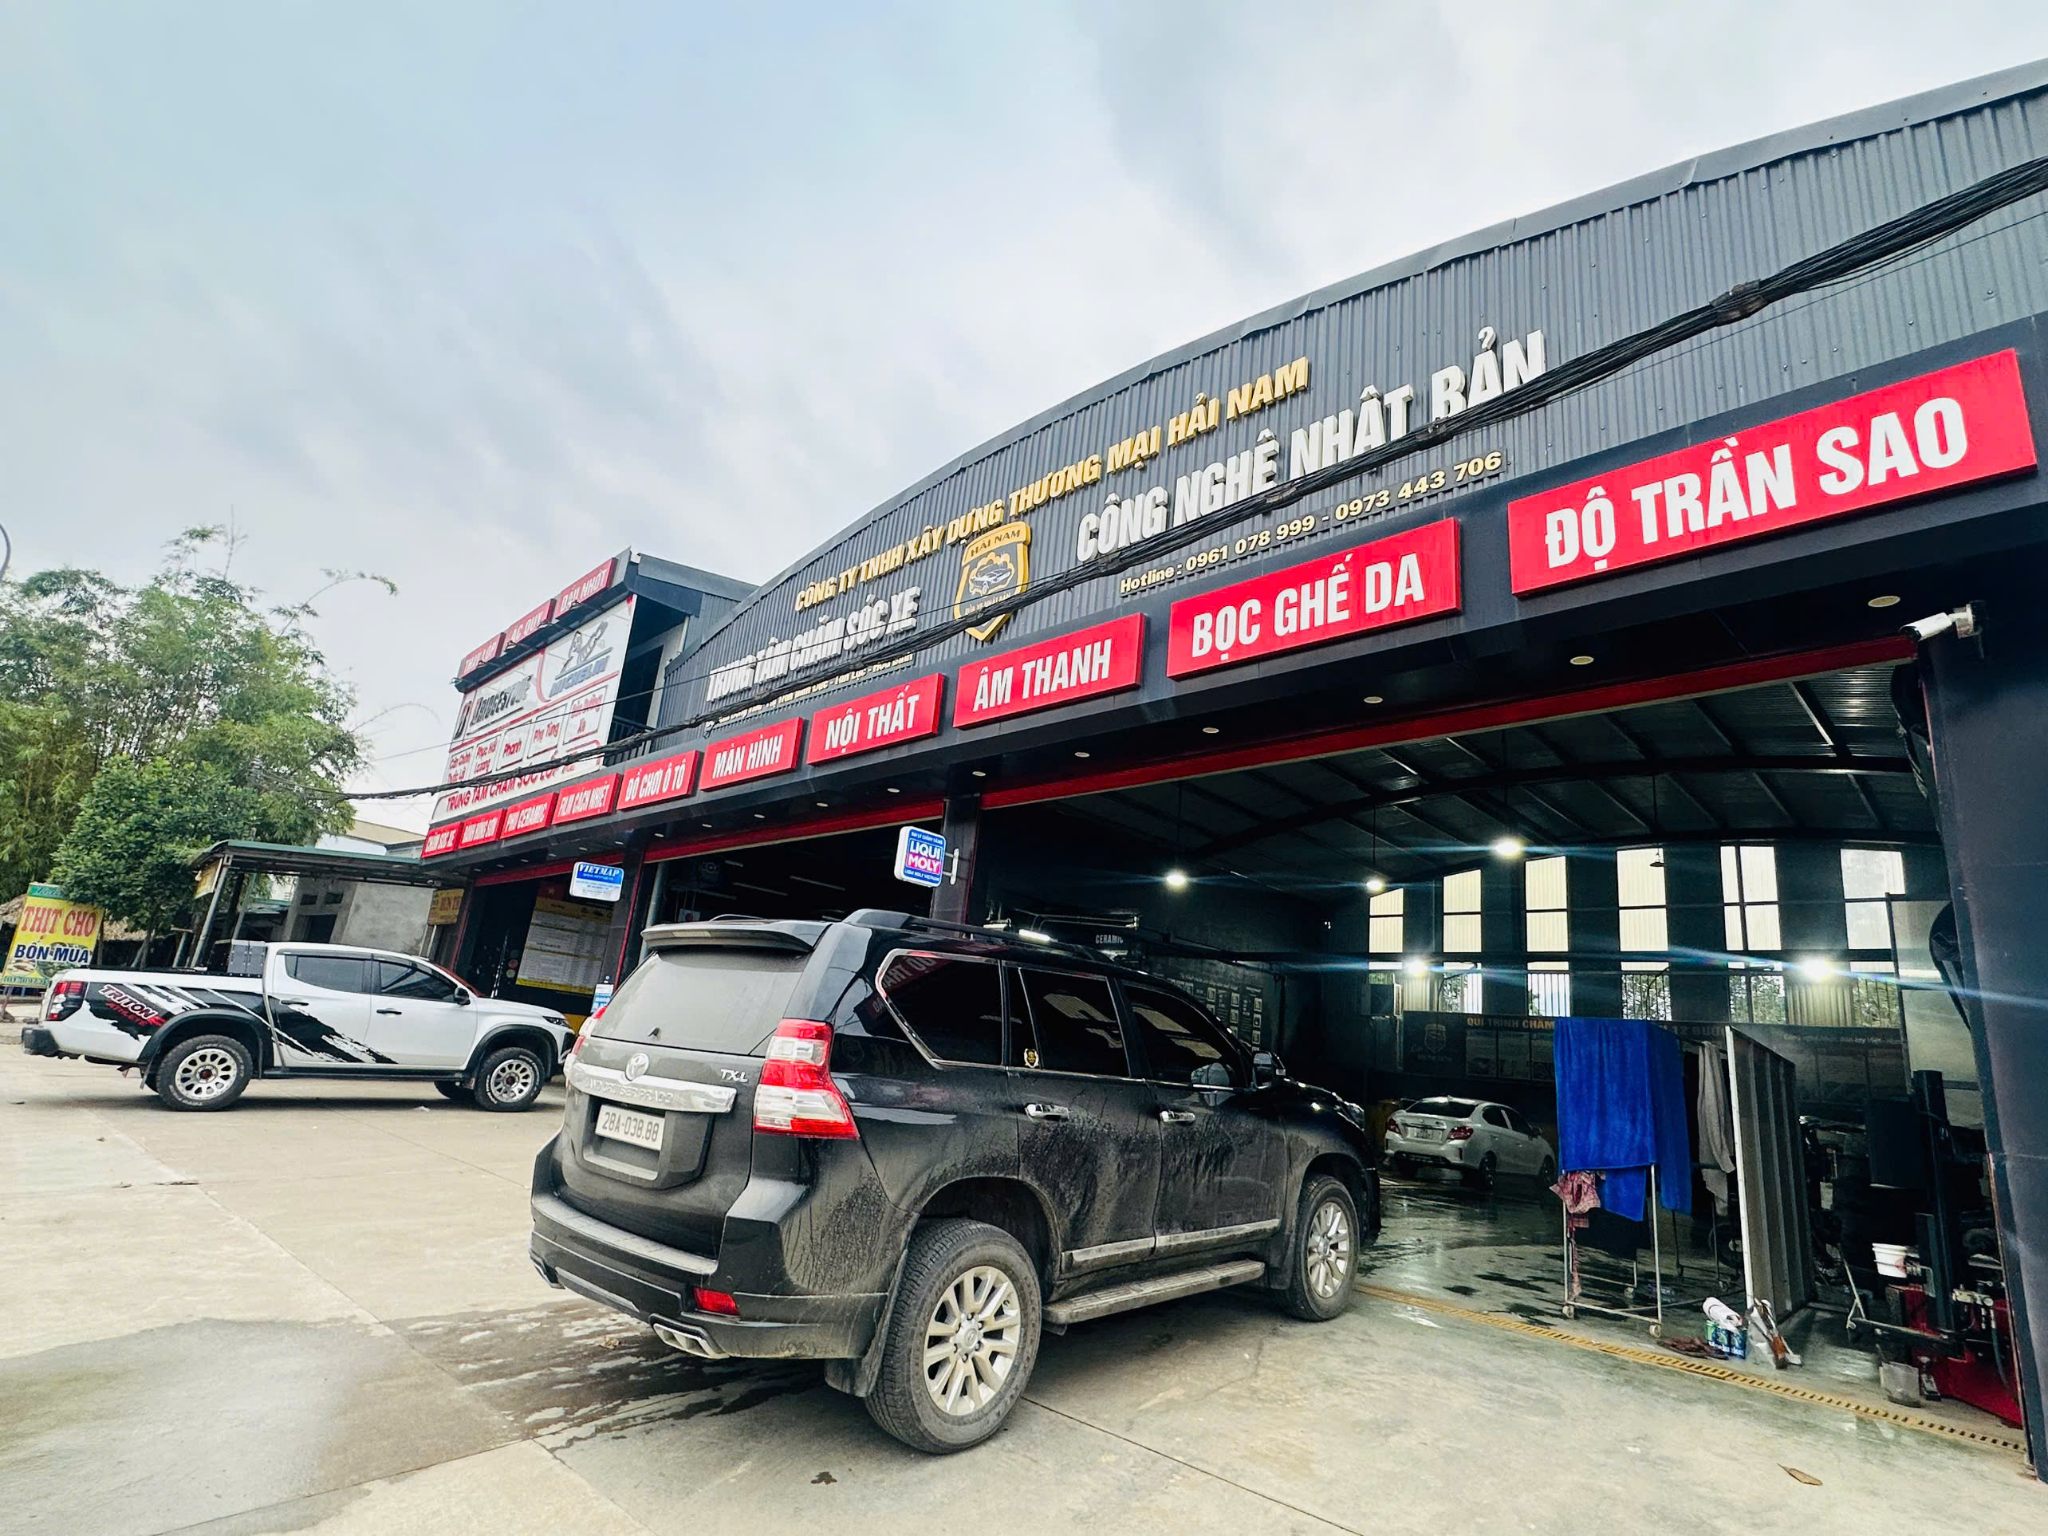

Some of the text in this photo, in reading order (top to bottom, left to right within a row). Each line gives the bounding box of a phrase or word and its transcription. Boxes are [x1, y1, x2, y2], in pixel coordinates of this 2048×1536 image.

[1076, 490, 1169, 563] CÔNG
[1430, 325, 1547, 422] BẢN
[794, 357, 1309, 612] CÔNG TY TNHH XÂY DỰNG THƯƠNG MẠI HẢI NAM
[1544, 397, 1969, 571] ĐỘ TRẦN SAO
[1119, 562, 1175, 595] Hotline
[1185, 548, 1229, 573] 0961
[1233, 529, 1272, 556] 078
[1275, 514, 1317, 542] 999
[1334, 490, 1391, 522] 0973
[1396, 469, 1446, 500] 443
[1453, 450, 1503, 483] 706
[1191, 552, 1425, 661] BỌC GHẾ DA
[706, 585, 922, 703] TRUNG TÂM CHĂM SÓC XE
[973, 638, 1113, 712] ÂM THANH
[825, 707, 860, 752] NỘI
[867, 684, 920, 738] THẤT
[671, 758, 687, 791] TÔ
[712, 734, 783, 779] MÀN HÌNH
[579, 864, 620, 877] VIETMAP
[907, 853, 941, 875] MOLY
[909, 840, 941, 861] LIQUI
[98, 983, 159, 1020] TRITON
